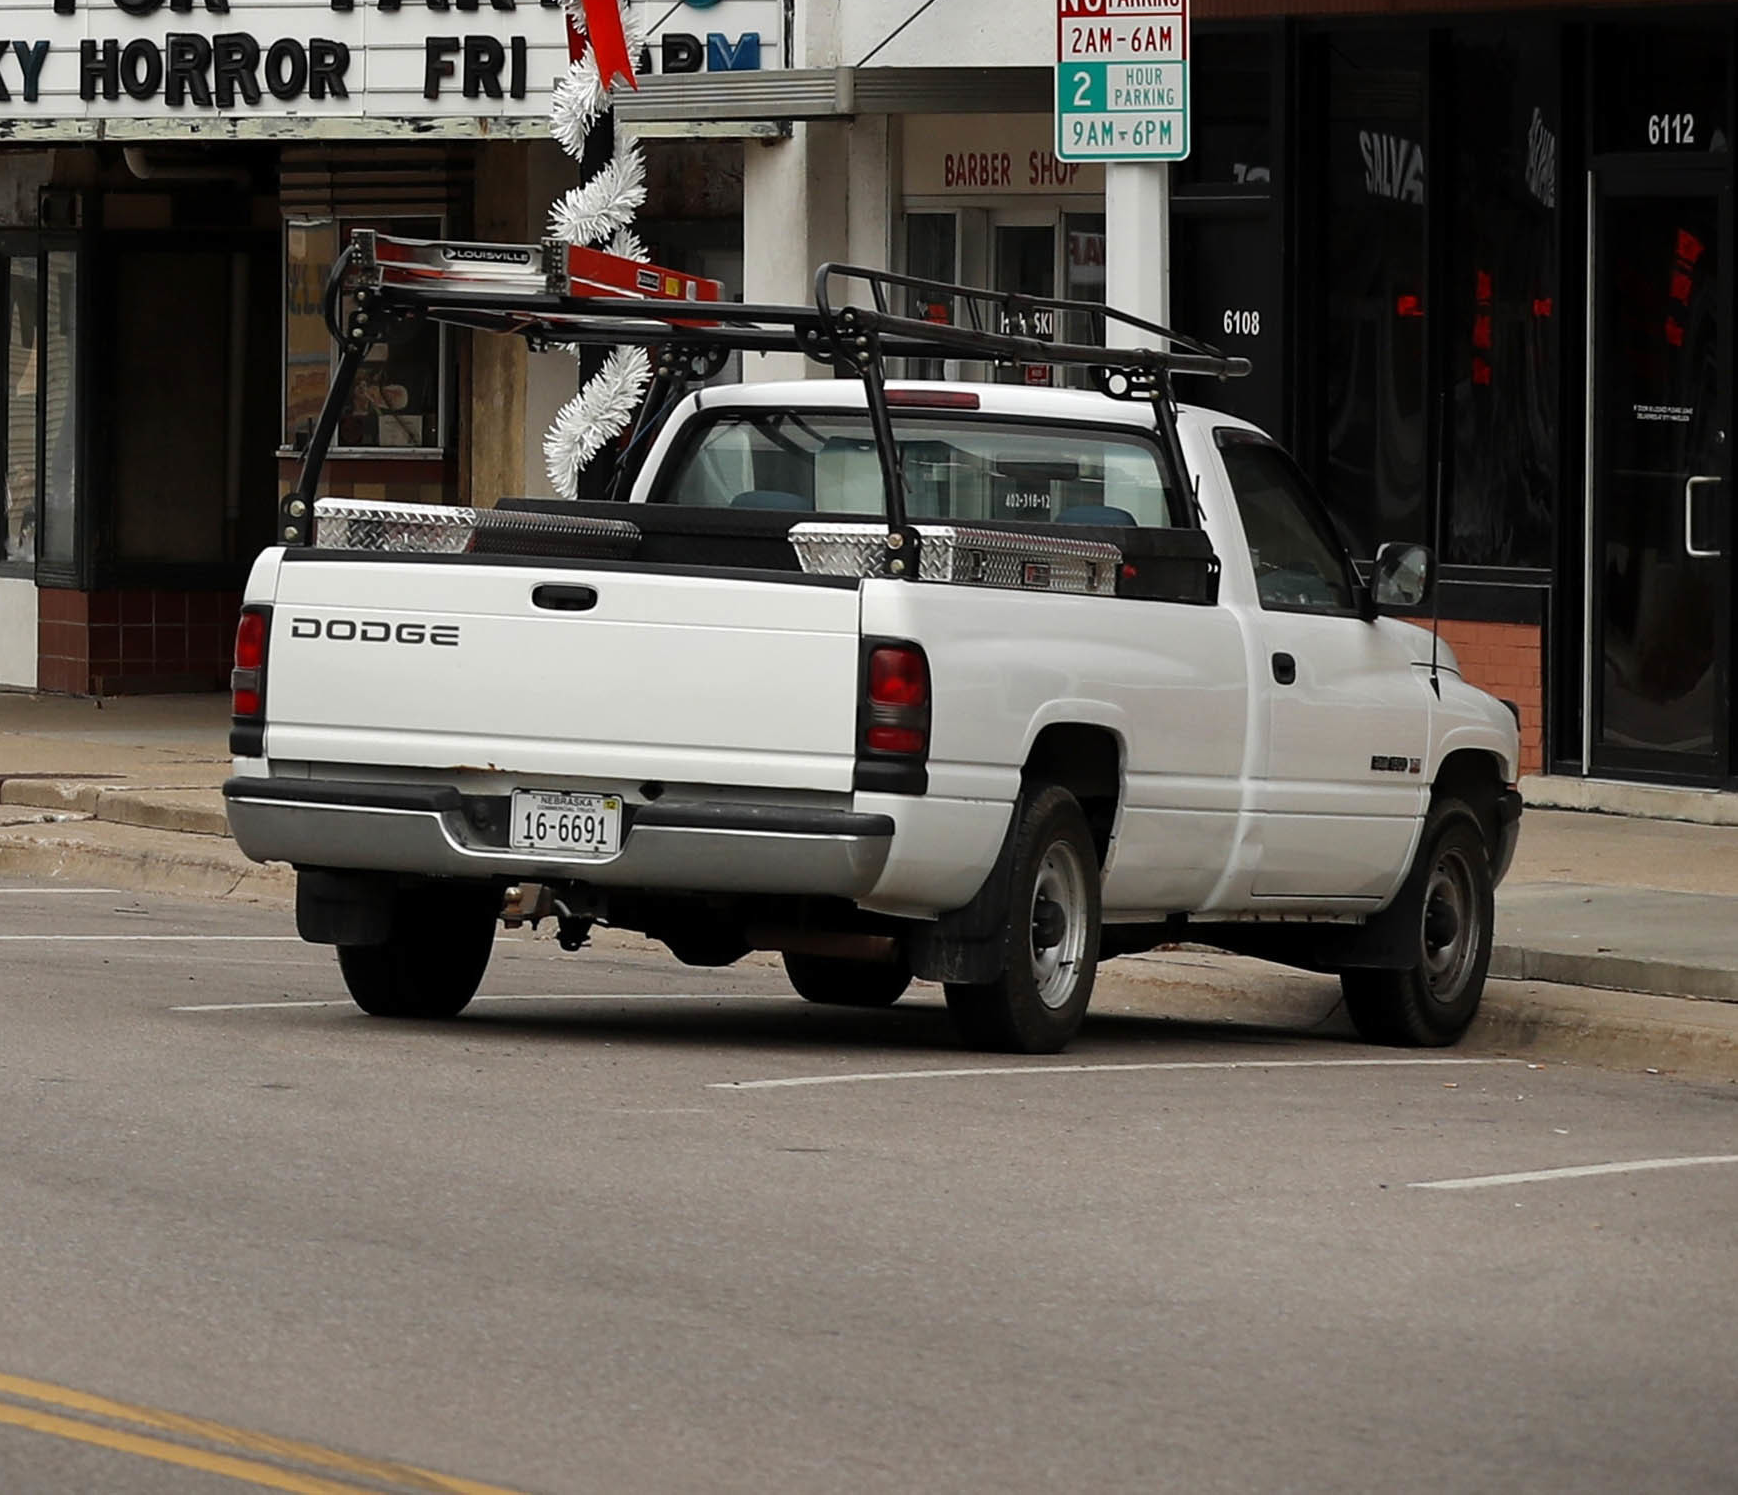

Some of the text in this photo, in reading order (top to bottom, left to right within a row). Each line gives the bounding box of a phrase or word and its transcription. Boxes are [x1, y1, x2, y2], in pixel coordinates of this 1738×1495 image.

[80, 33, 350, 107] HORROR
[424, 35, 525, 101] FRI
[635, 32, 761, 76] PM
[1073, 68, 1163, 106] 2 HOUR
[1114, 88, 1174, 106] PARKING
[1648, 113, 1694, 145] 6112
[944, 151, 1081, 187] BARBER SHOP
[457, 250, 529, 262] LOUISVILLE
[1223, 310, 1260, 335] 6108
[291, 618, 460, 646] DODGE
[540, 795, 593, 807] NEBRASKA
[523, 811, 607, 845] 16-6691
